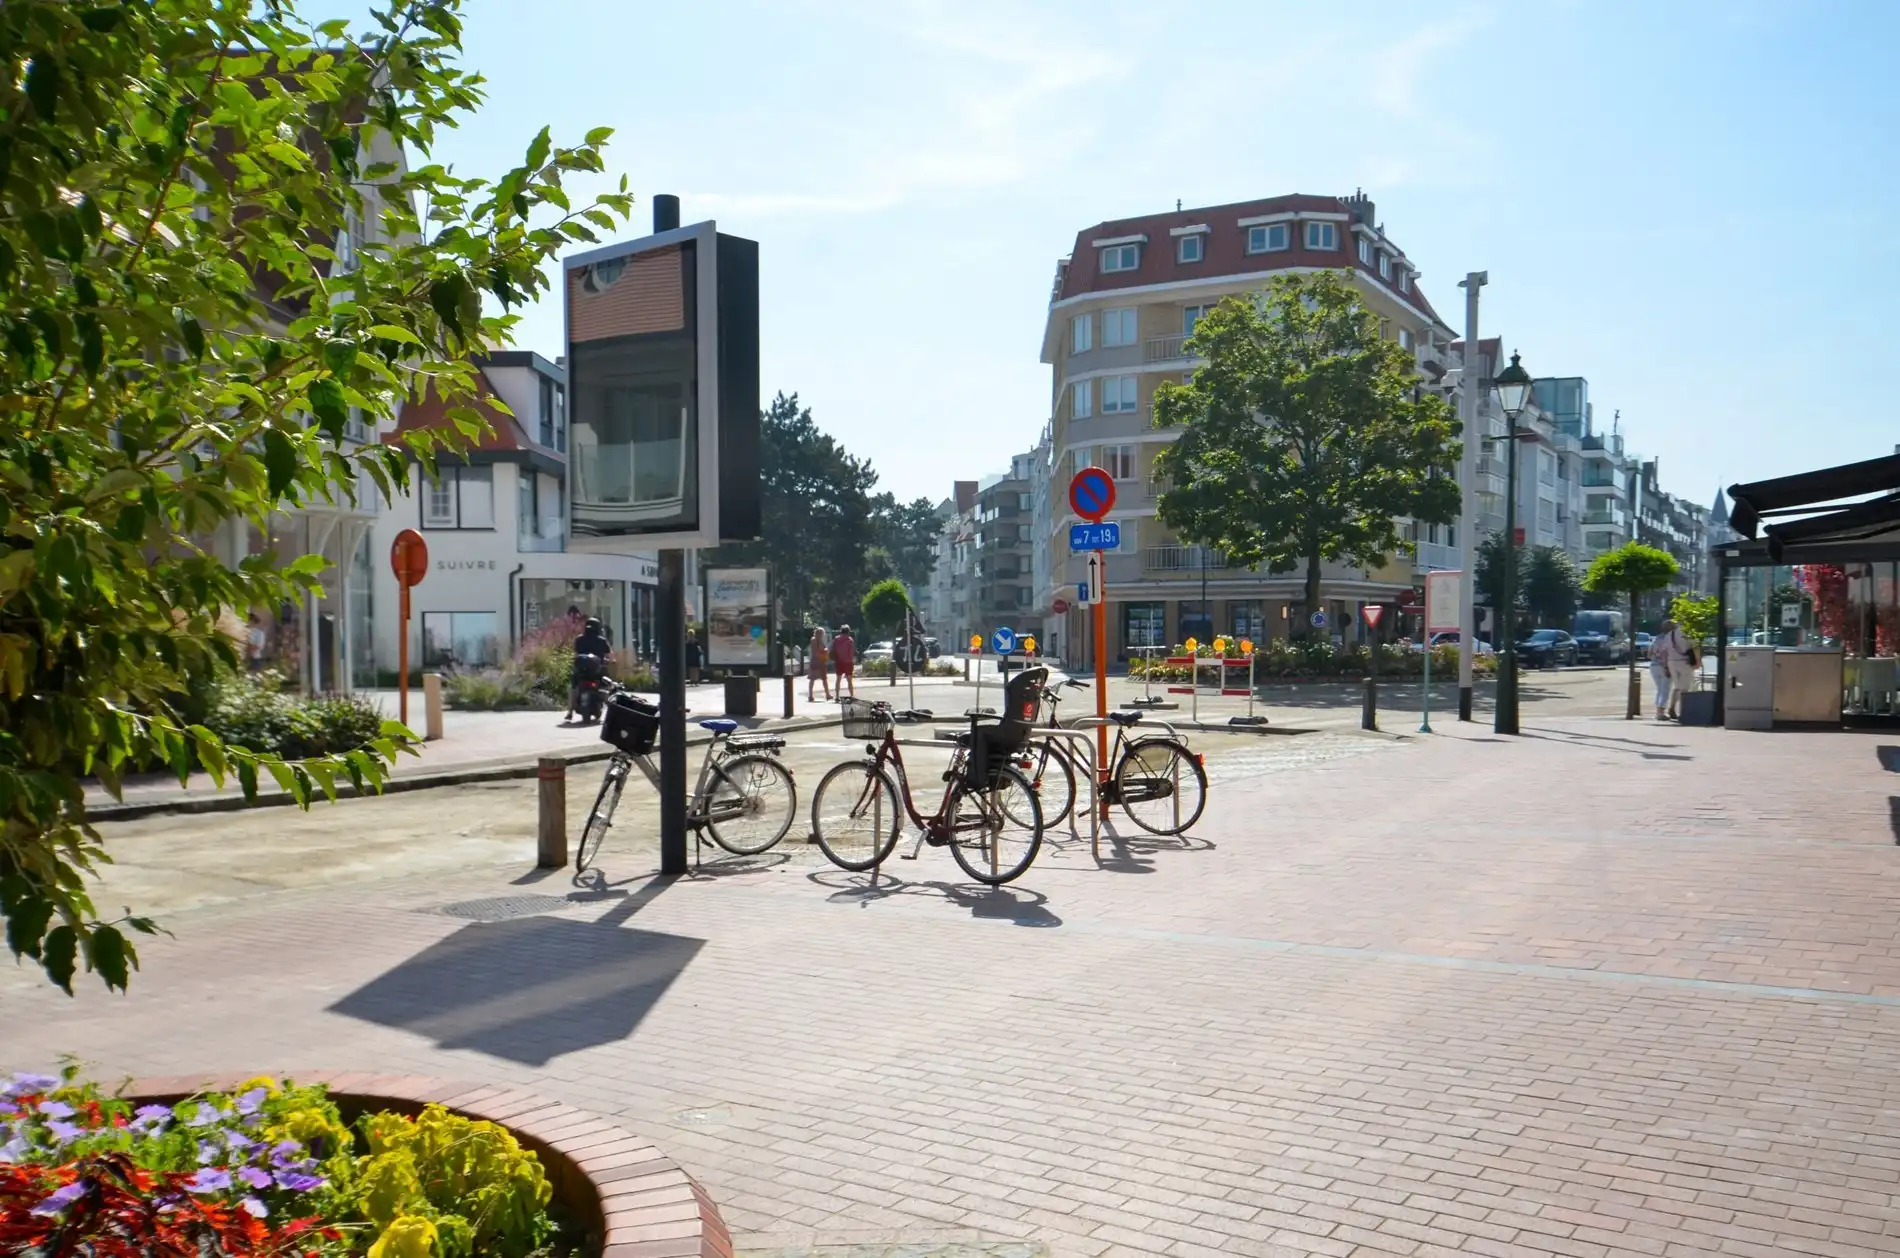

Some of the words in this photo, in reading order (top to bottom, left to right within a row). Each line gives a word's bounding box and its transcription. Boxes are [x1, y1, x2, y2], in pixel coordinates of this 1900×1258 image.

[1084, 530, 1090, 544] 7
[1100, 528, 1111, 543] 19
[437, 560, 497, 571] SUIVRE
